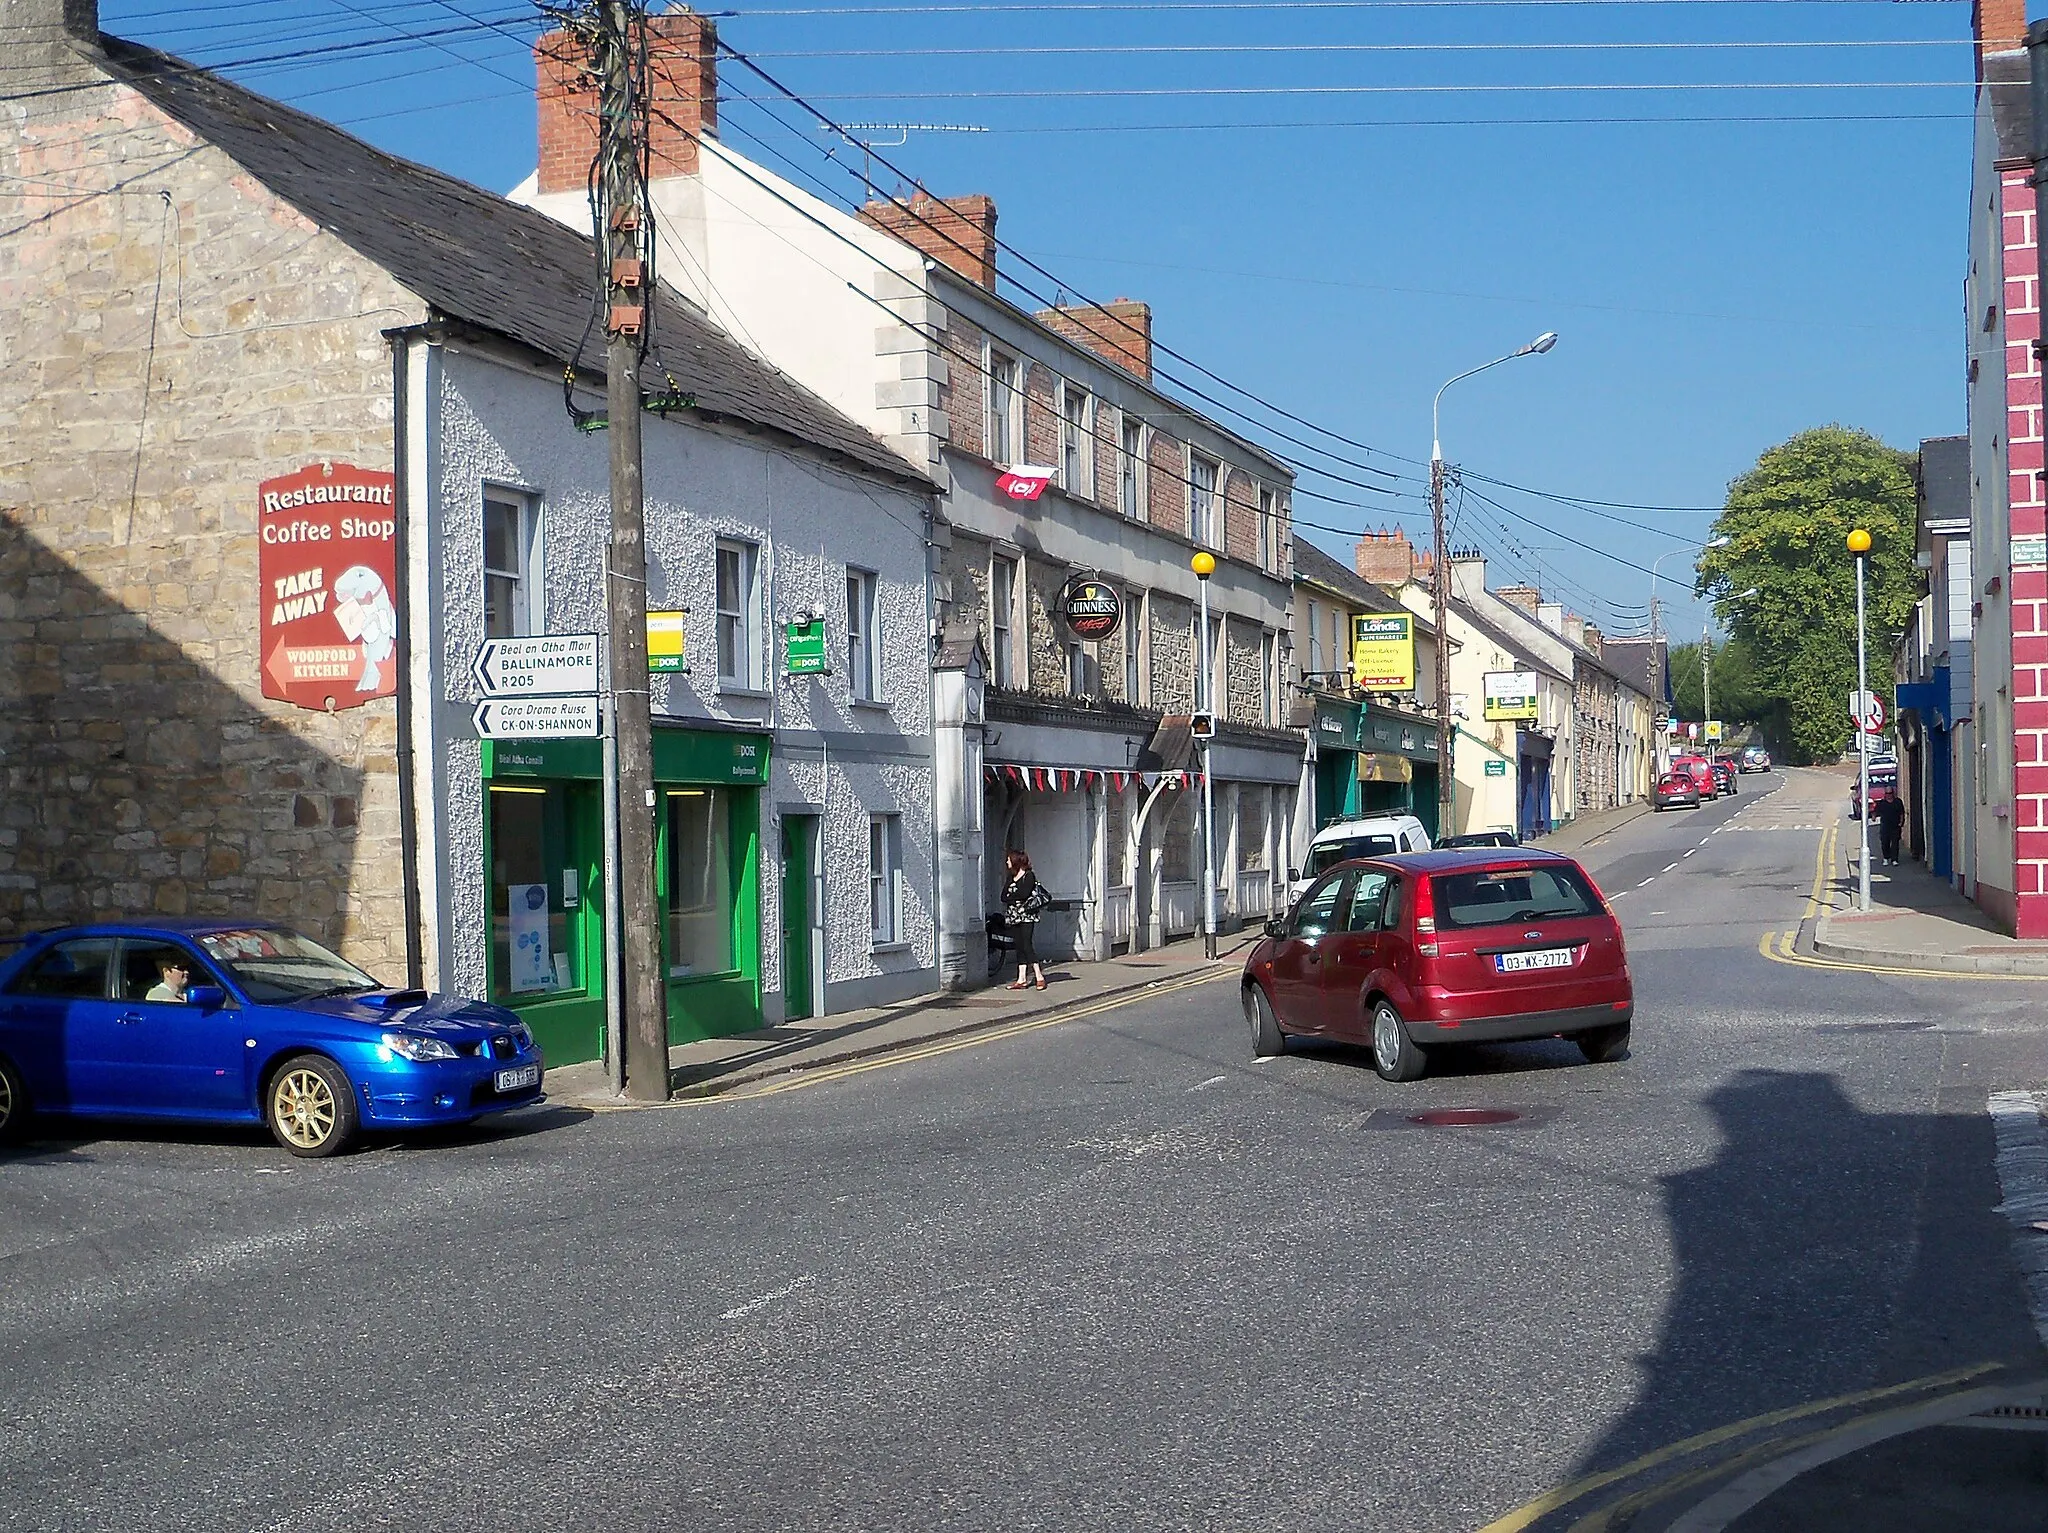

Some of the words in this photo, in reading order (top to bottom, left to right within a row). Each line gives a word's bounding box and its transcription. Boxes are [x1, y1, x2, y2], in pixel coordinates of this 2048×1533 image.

[264, 484, 392, 514] Restaurant
[263, 520, 331, 544] Coffee
[341, 518, 395, 541] Shop
[274, 568, 323, 599] TAKE
[271, 591, 328, 626] AWAY
[1067, 601, 1117, 613] GUINNESS
[1364, 621, 1400, 632] Londis
[287, 649, 356, 664] WOODFORD
[501, 656, 593, 670] BALLINAMORE
[659, 658, 680, 667] post
[802, 659, 820, 667] post
[293, 664, 349, 678] KITCHEN
[501, 675, 534, 687] R205
[526, 705, 557, 715] Droma
[561, 704, 586, 714] Ruisc
[501, 719, 592, 731] CK-ON-SHANNON
[1506, 953, 1568, 970] 03-WX-2772
